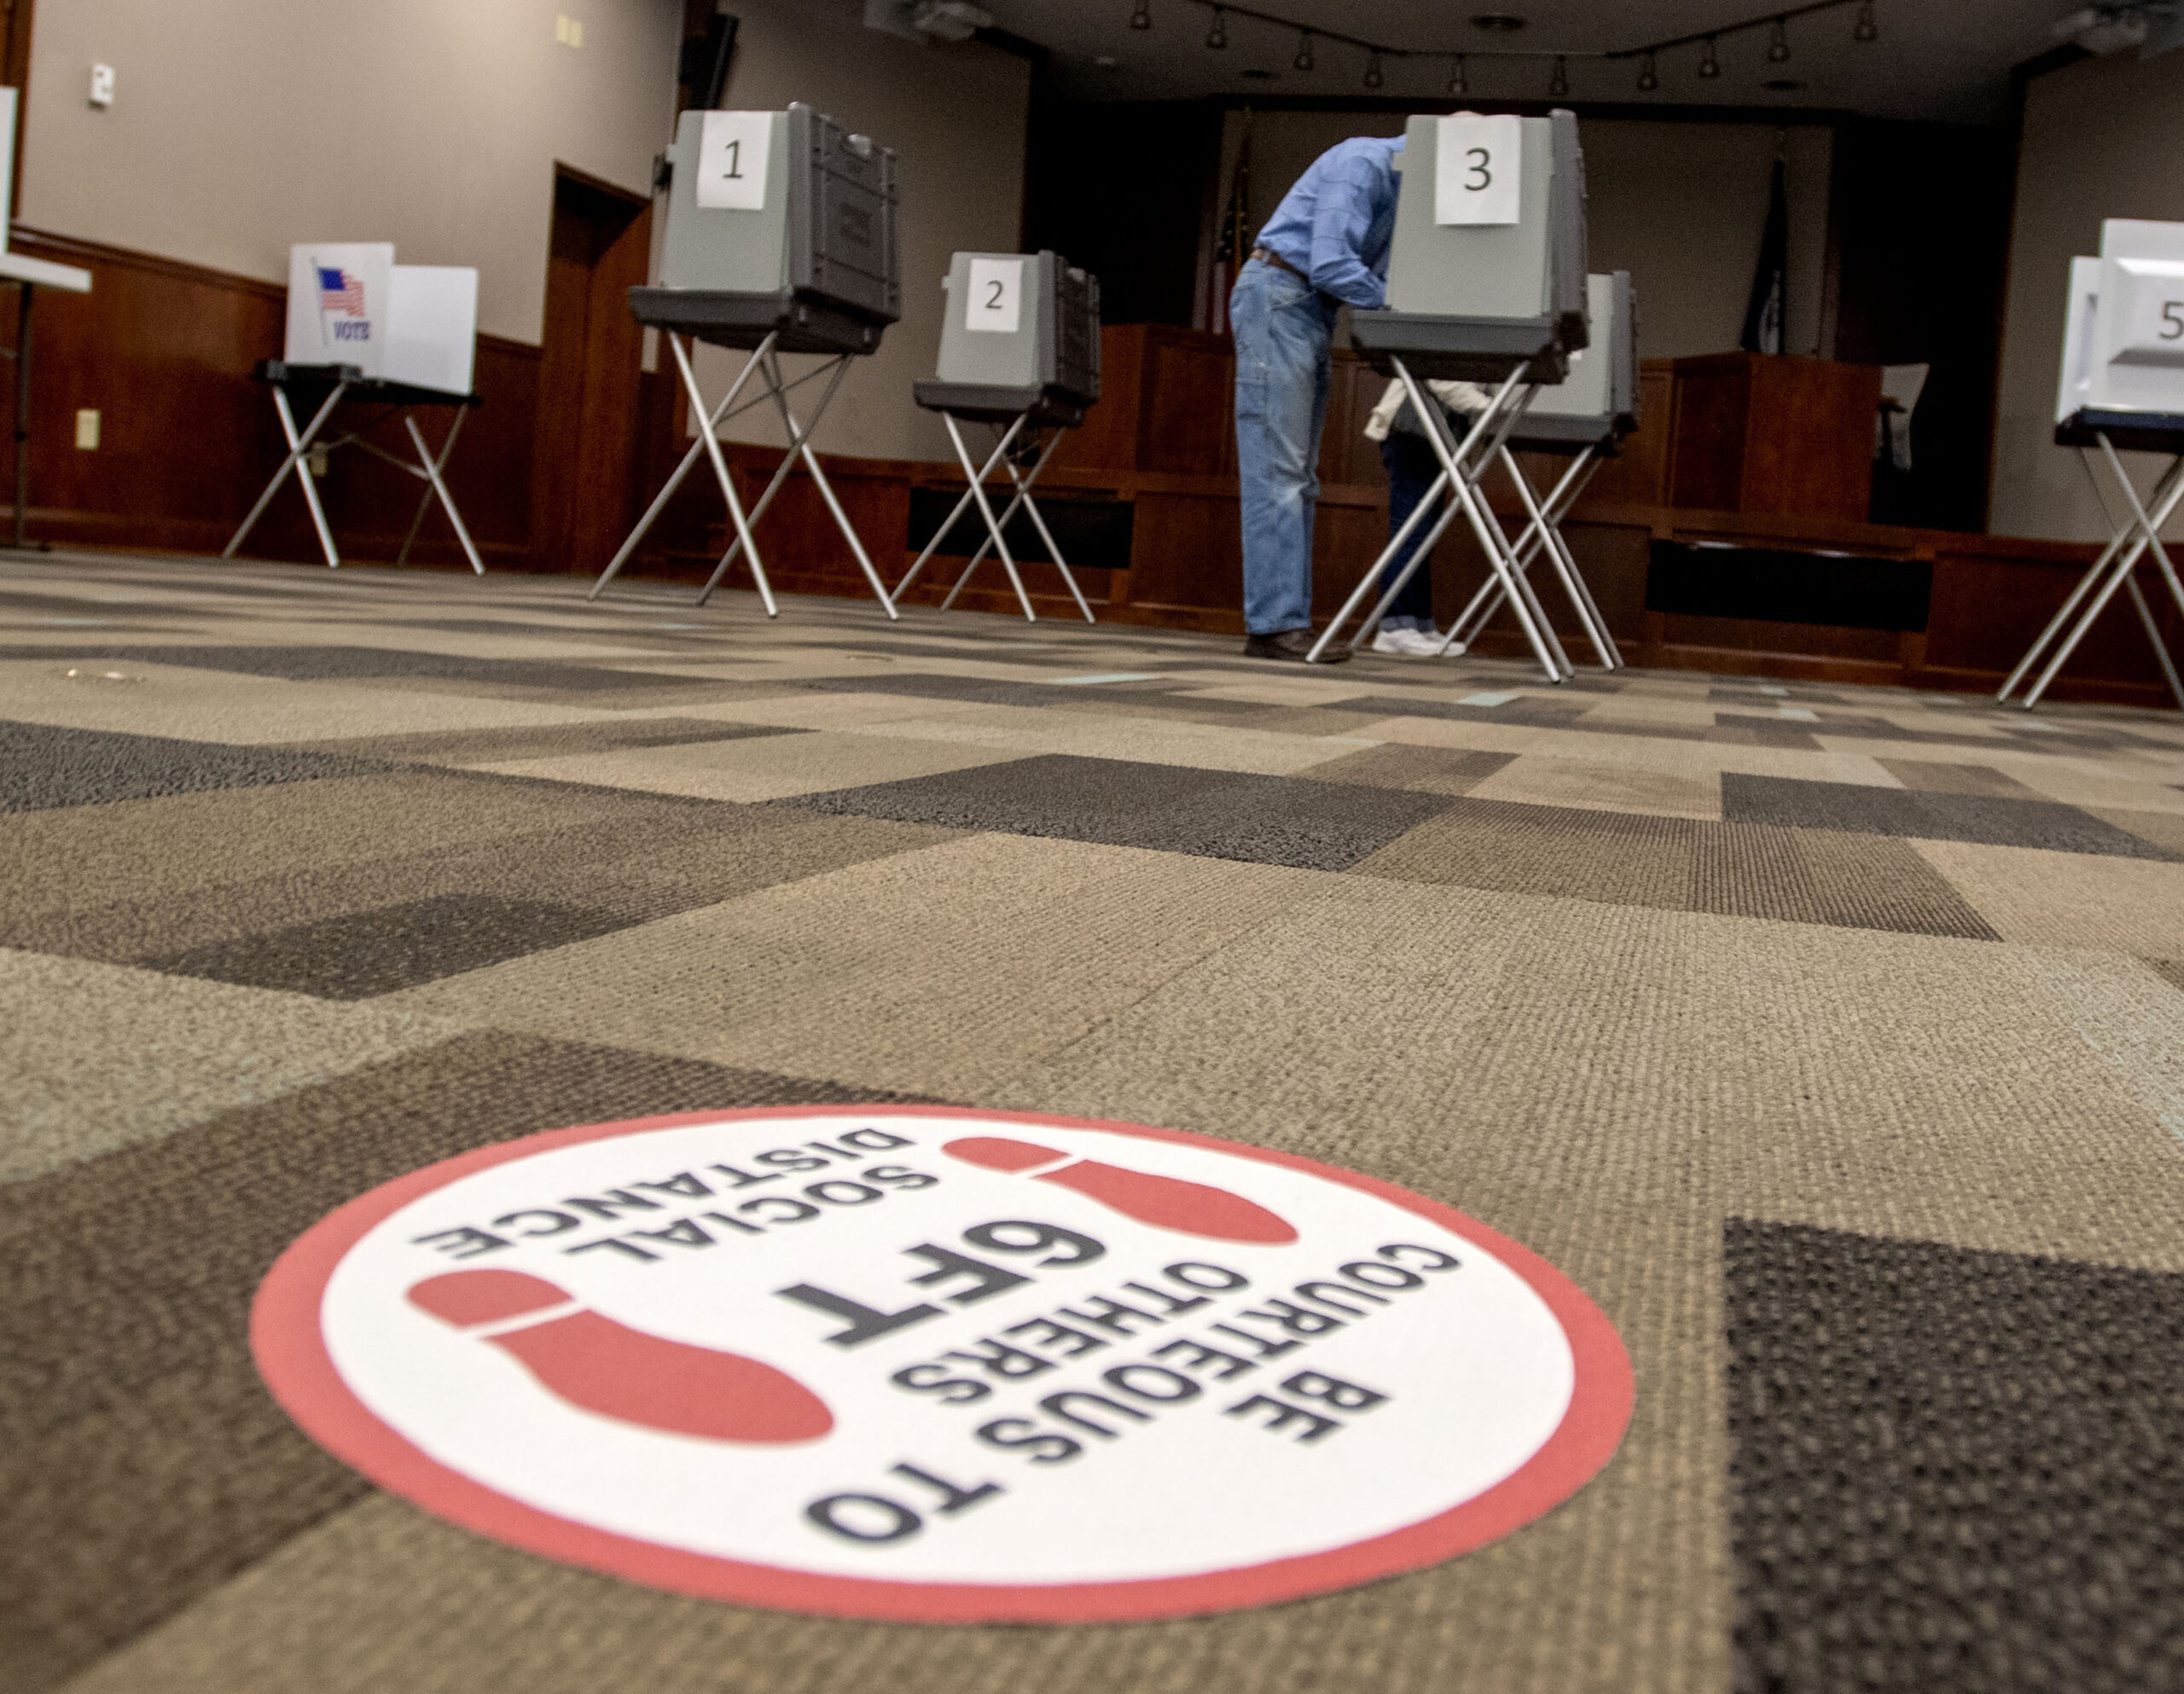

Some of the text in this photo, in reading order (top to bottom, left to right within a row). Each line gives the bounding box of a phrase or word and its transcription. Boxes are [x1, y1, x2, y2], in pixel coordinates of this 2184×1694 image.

[723, 139, 743, 179] 1
[1464, 147, 1492, 192] 3
[334, 321, 370, 341] VOTE
[985, 280, 1003, 310] 2
[2158, 300, 2184, 341] 5
[411, 1127, 916, 1258] DISTANCE
[563, 1165, 940, 1262] SOCIAL
[773, 1219, 1107, 1349] 6FT
[889, 1261, 1251, 1405] OTHERS
[804, 1242, 1462, 1546] COURTEOUS TO
[1224, 1368, 1391, 1443] BE
